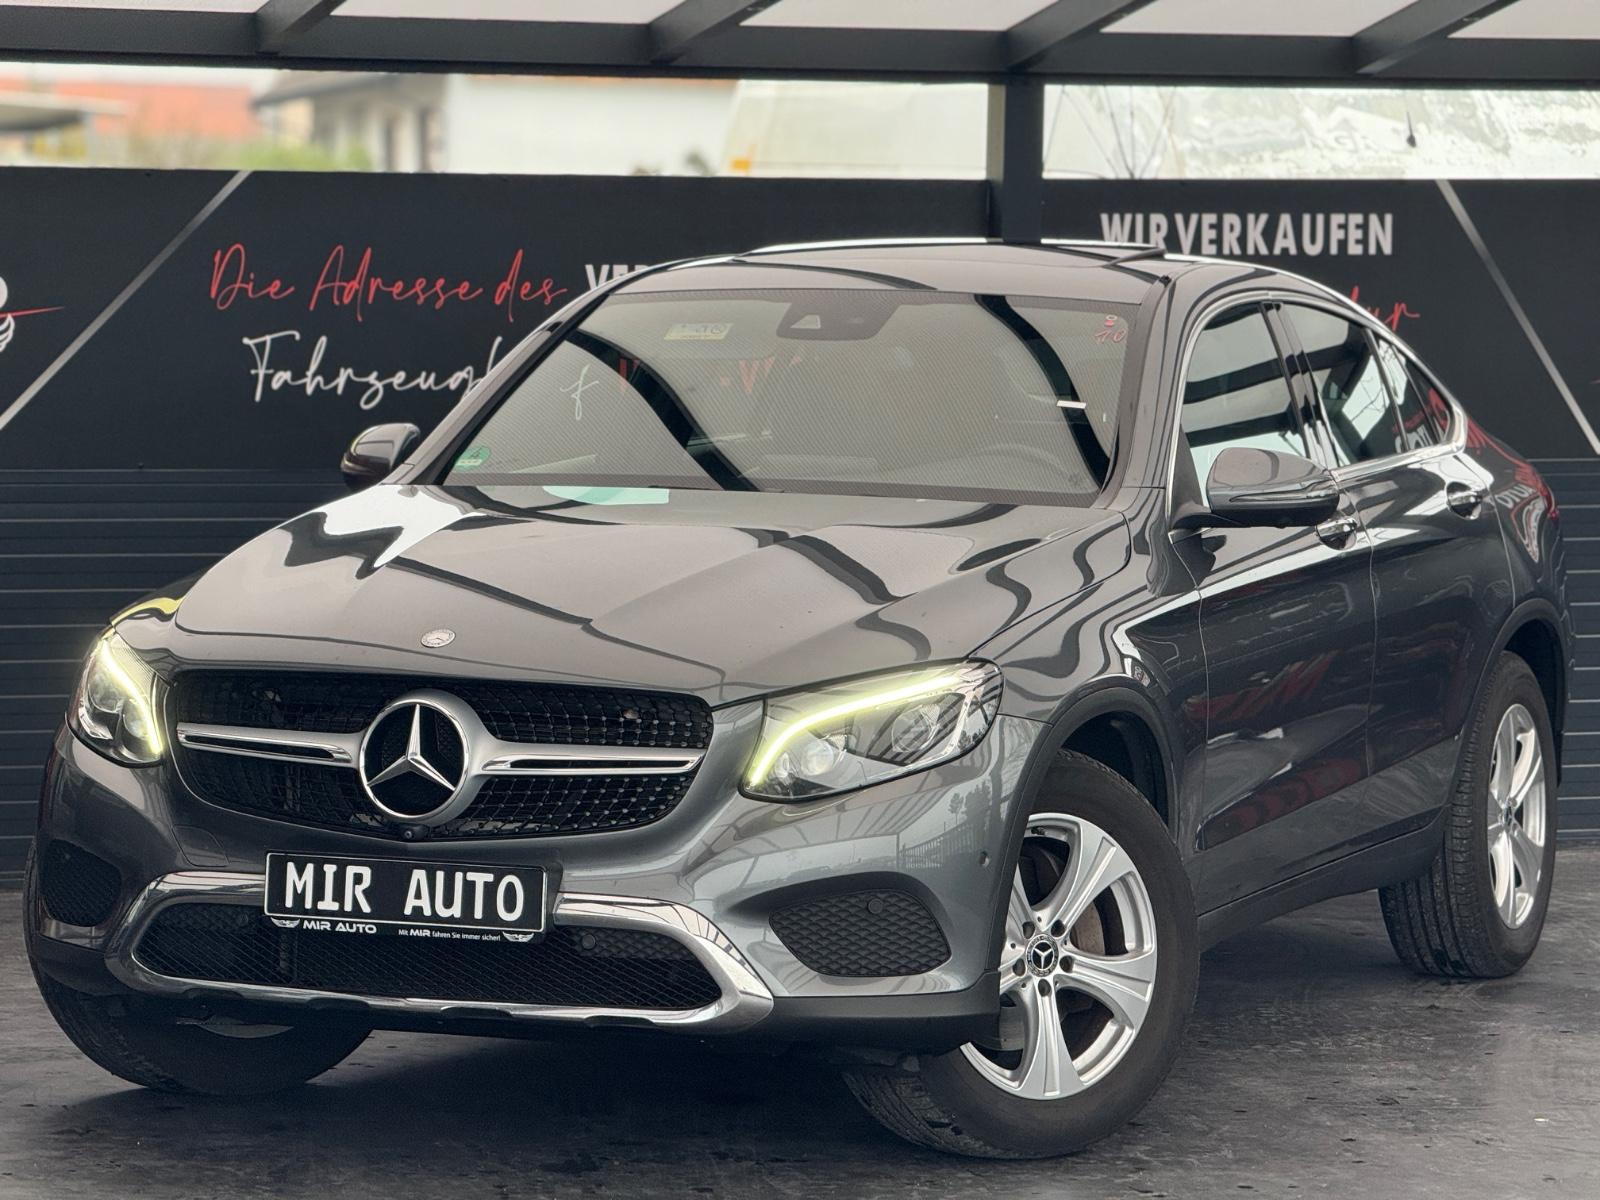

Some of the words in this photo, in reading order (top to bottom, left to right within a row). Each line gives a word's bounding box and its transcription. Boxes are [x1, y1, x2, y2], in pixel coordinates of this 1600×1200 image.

[1100, 213, 1169, 249] WIR
[1174, 213, 1393, 256] VERKAUFEN
[210, 243, 295, 310] Die
[309, 244, 485, 322] Adresse
[494, 249, 568, 322] des
[285, 861, 372, 914] MIR
[403, 869, 524, 922] AUTO
[302, 919, 331, 931] MIR
[335, 922, 377, 934] AUTO
[409, 928, 431, 937] MIR
[432, 931, 451, 939] fahren
